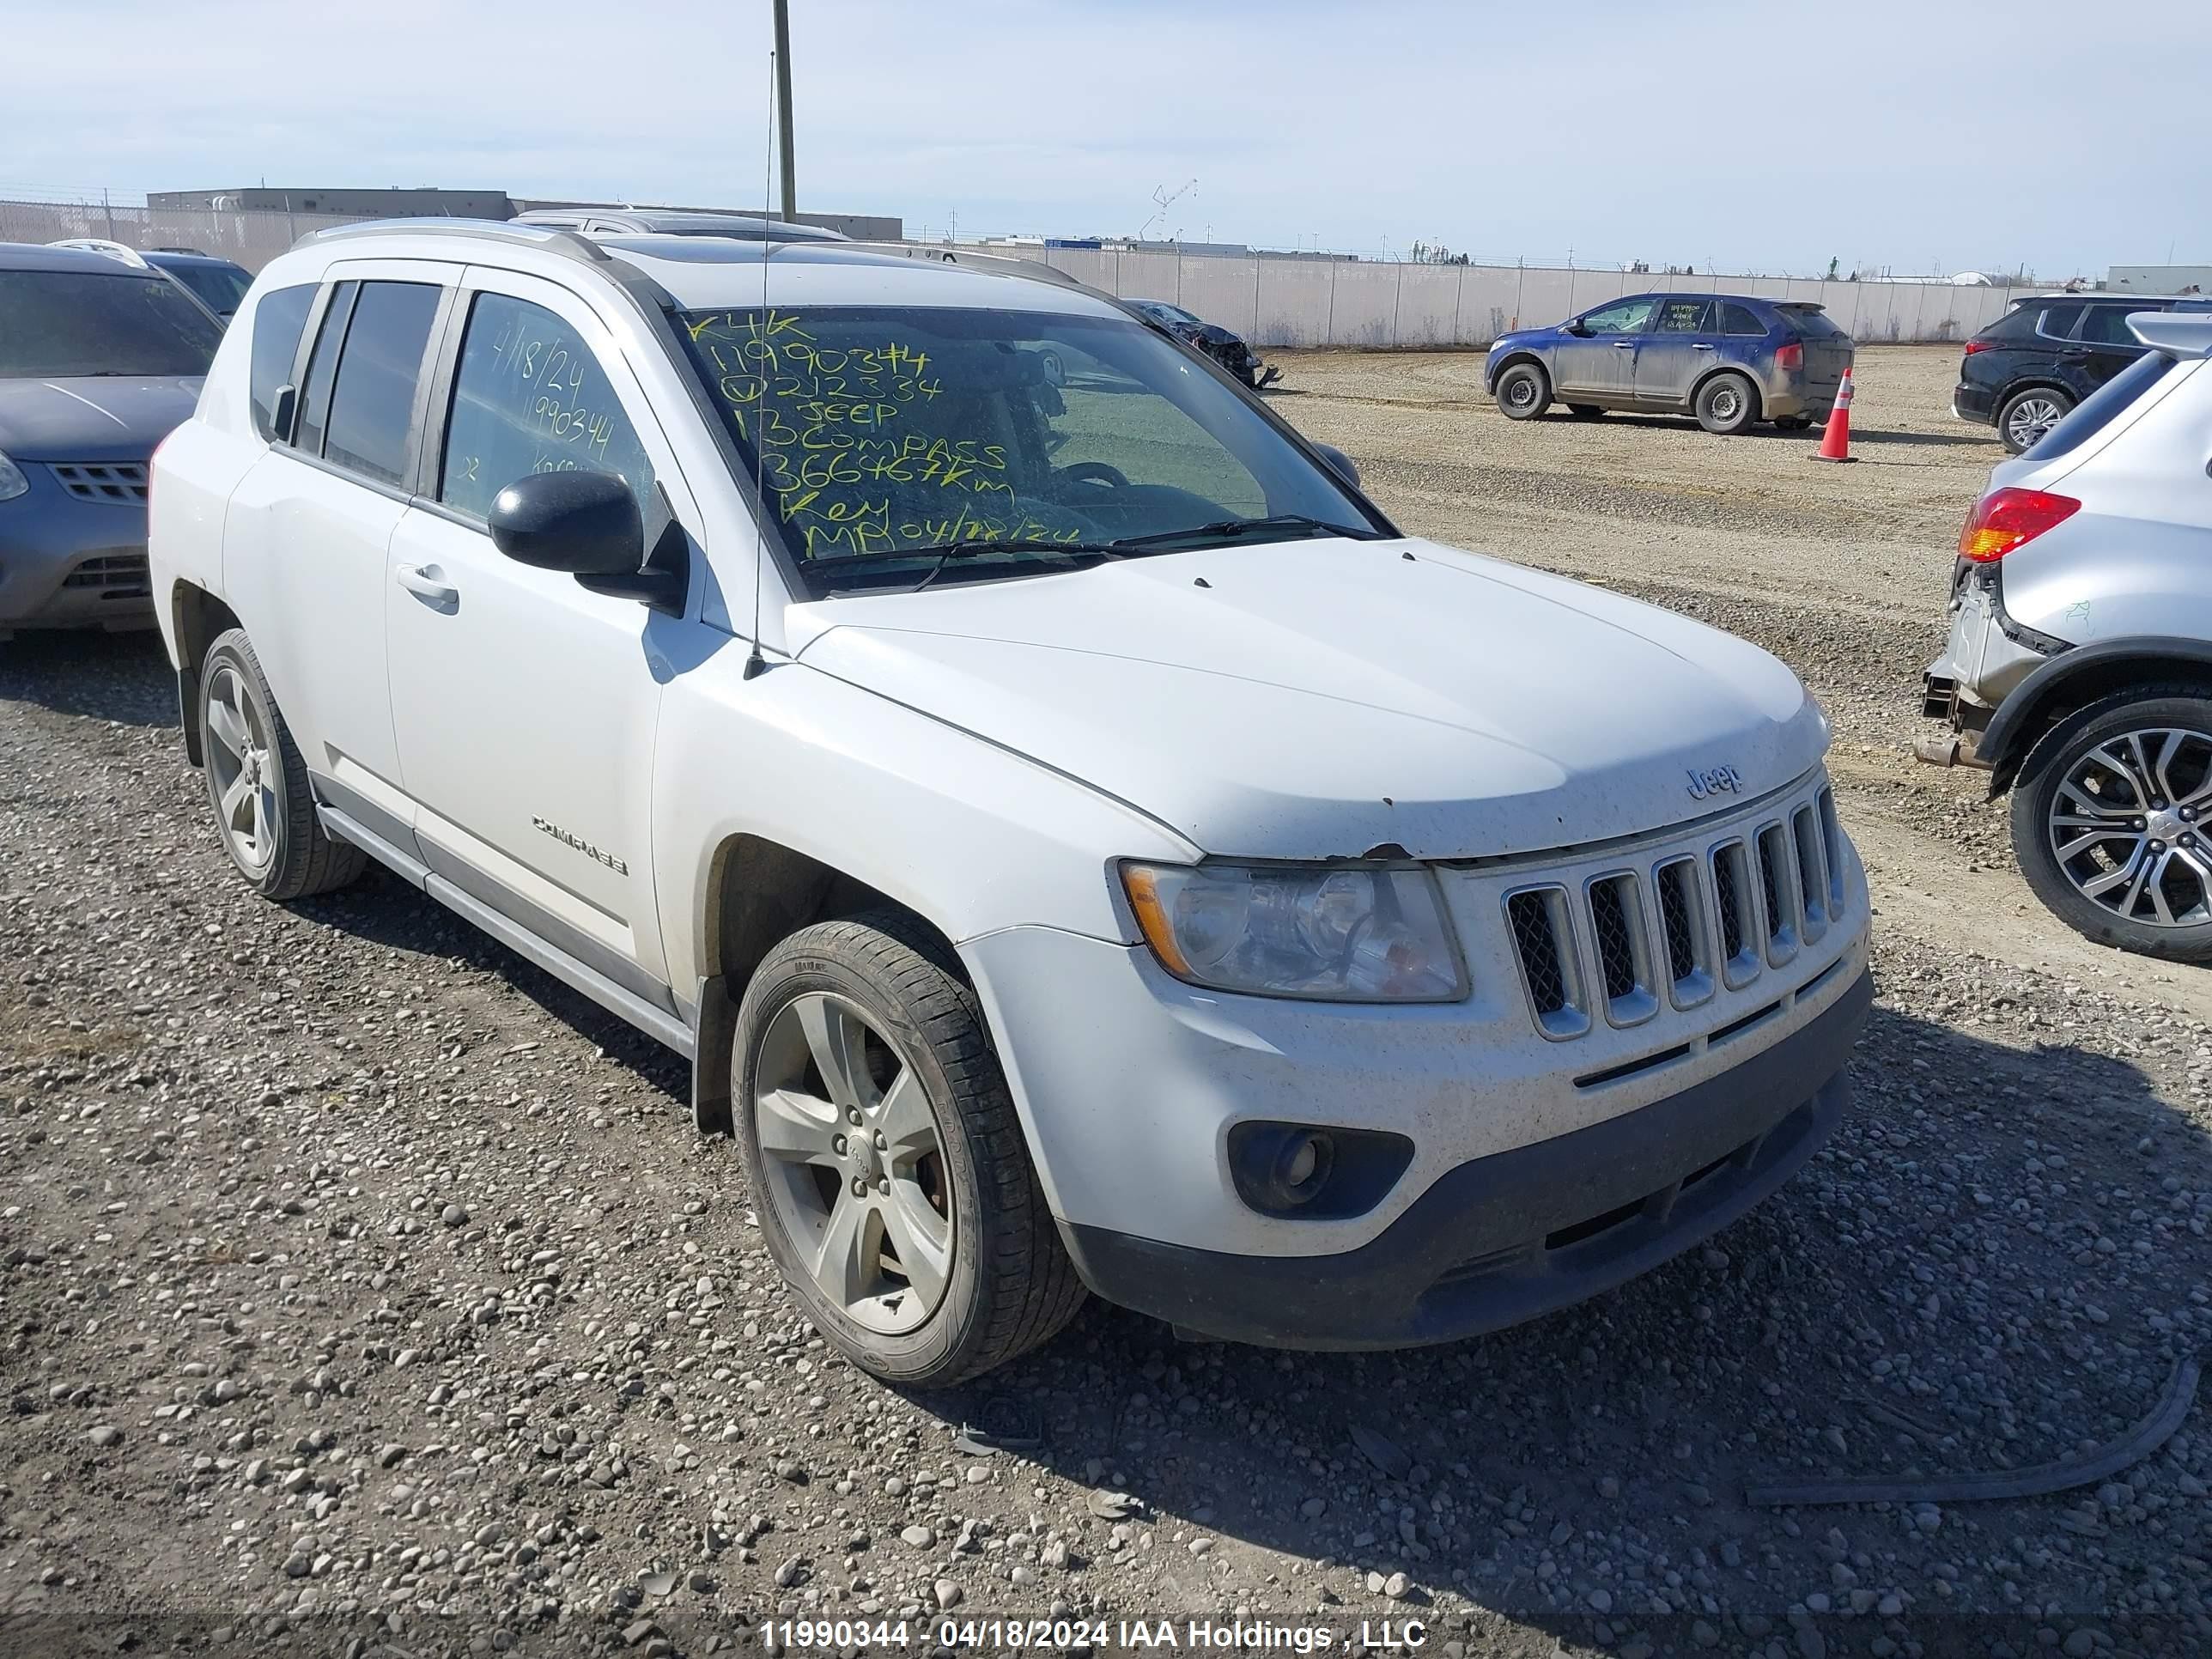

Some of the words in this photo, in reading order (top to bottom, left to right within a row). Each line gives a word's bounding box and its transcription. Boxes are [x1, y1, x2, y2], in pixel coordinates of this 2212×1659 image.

[492, 324, 584, 410] 4/18/24
[775, 376, 945, 403] 212334
[1686, 763, 1743, 800] Jeep
[531, 813, 629, 877] COMPASS
